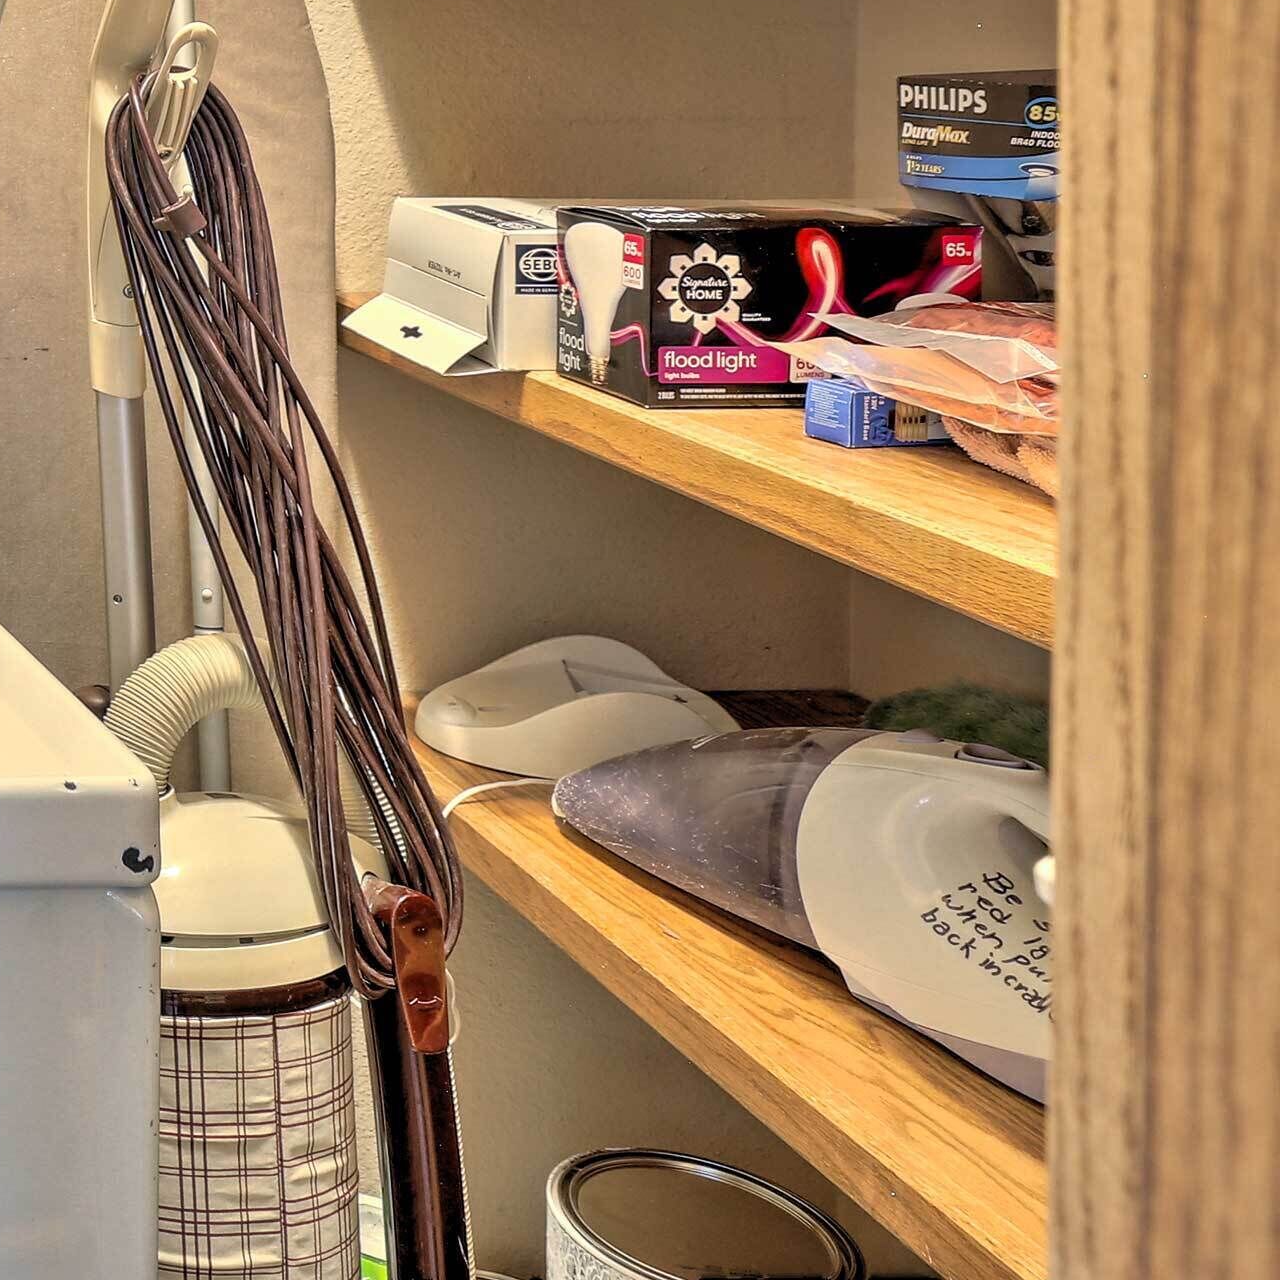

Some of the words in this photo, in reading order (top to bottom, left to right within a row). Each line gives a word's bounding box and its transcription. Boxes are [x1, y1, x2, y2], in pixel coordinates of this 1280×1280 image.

[899, 83, 988, 114] PHILIPS
[1010, 137, 1035, 146] BR40
[1036, 139, 1060, 149] FLOO
[1031, 130, 1060, 140] INDOO
[624, 265, 641, 280] 600
[681, 275, 729, 290] Signature
[686, 289, 723, 300] HOME
[559, 326, 584, 351] flood
[559, 345, 582, 372] light
[664, 351, 713, 368] flood
[716, 351, 757, 373] light
[664, 372, 680, 381] light
[681, 372, 700, 380] bulbs
[982, 871, 1023, 905] Be
[958, 882, 1013, 924] red
[941, 893, 1003, 949] when
[920, 907, 977, 959] back
[978, 951, 1002, 976] in
